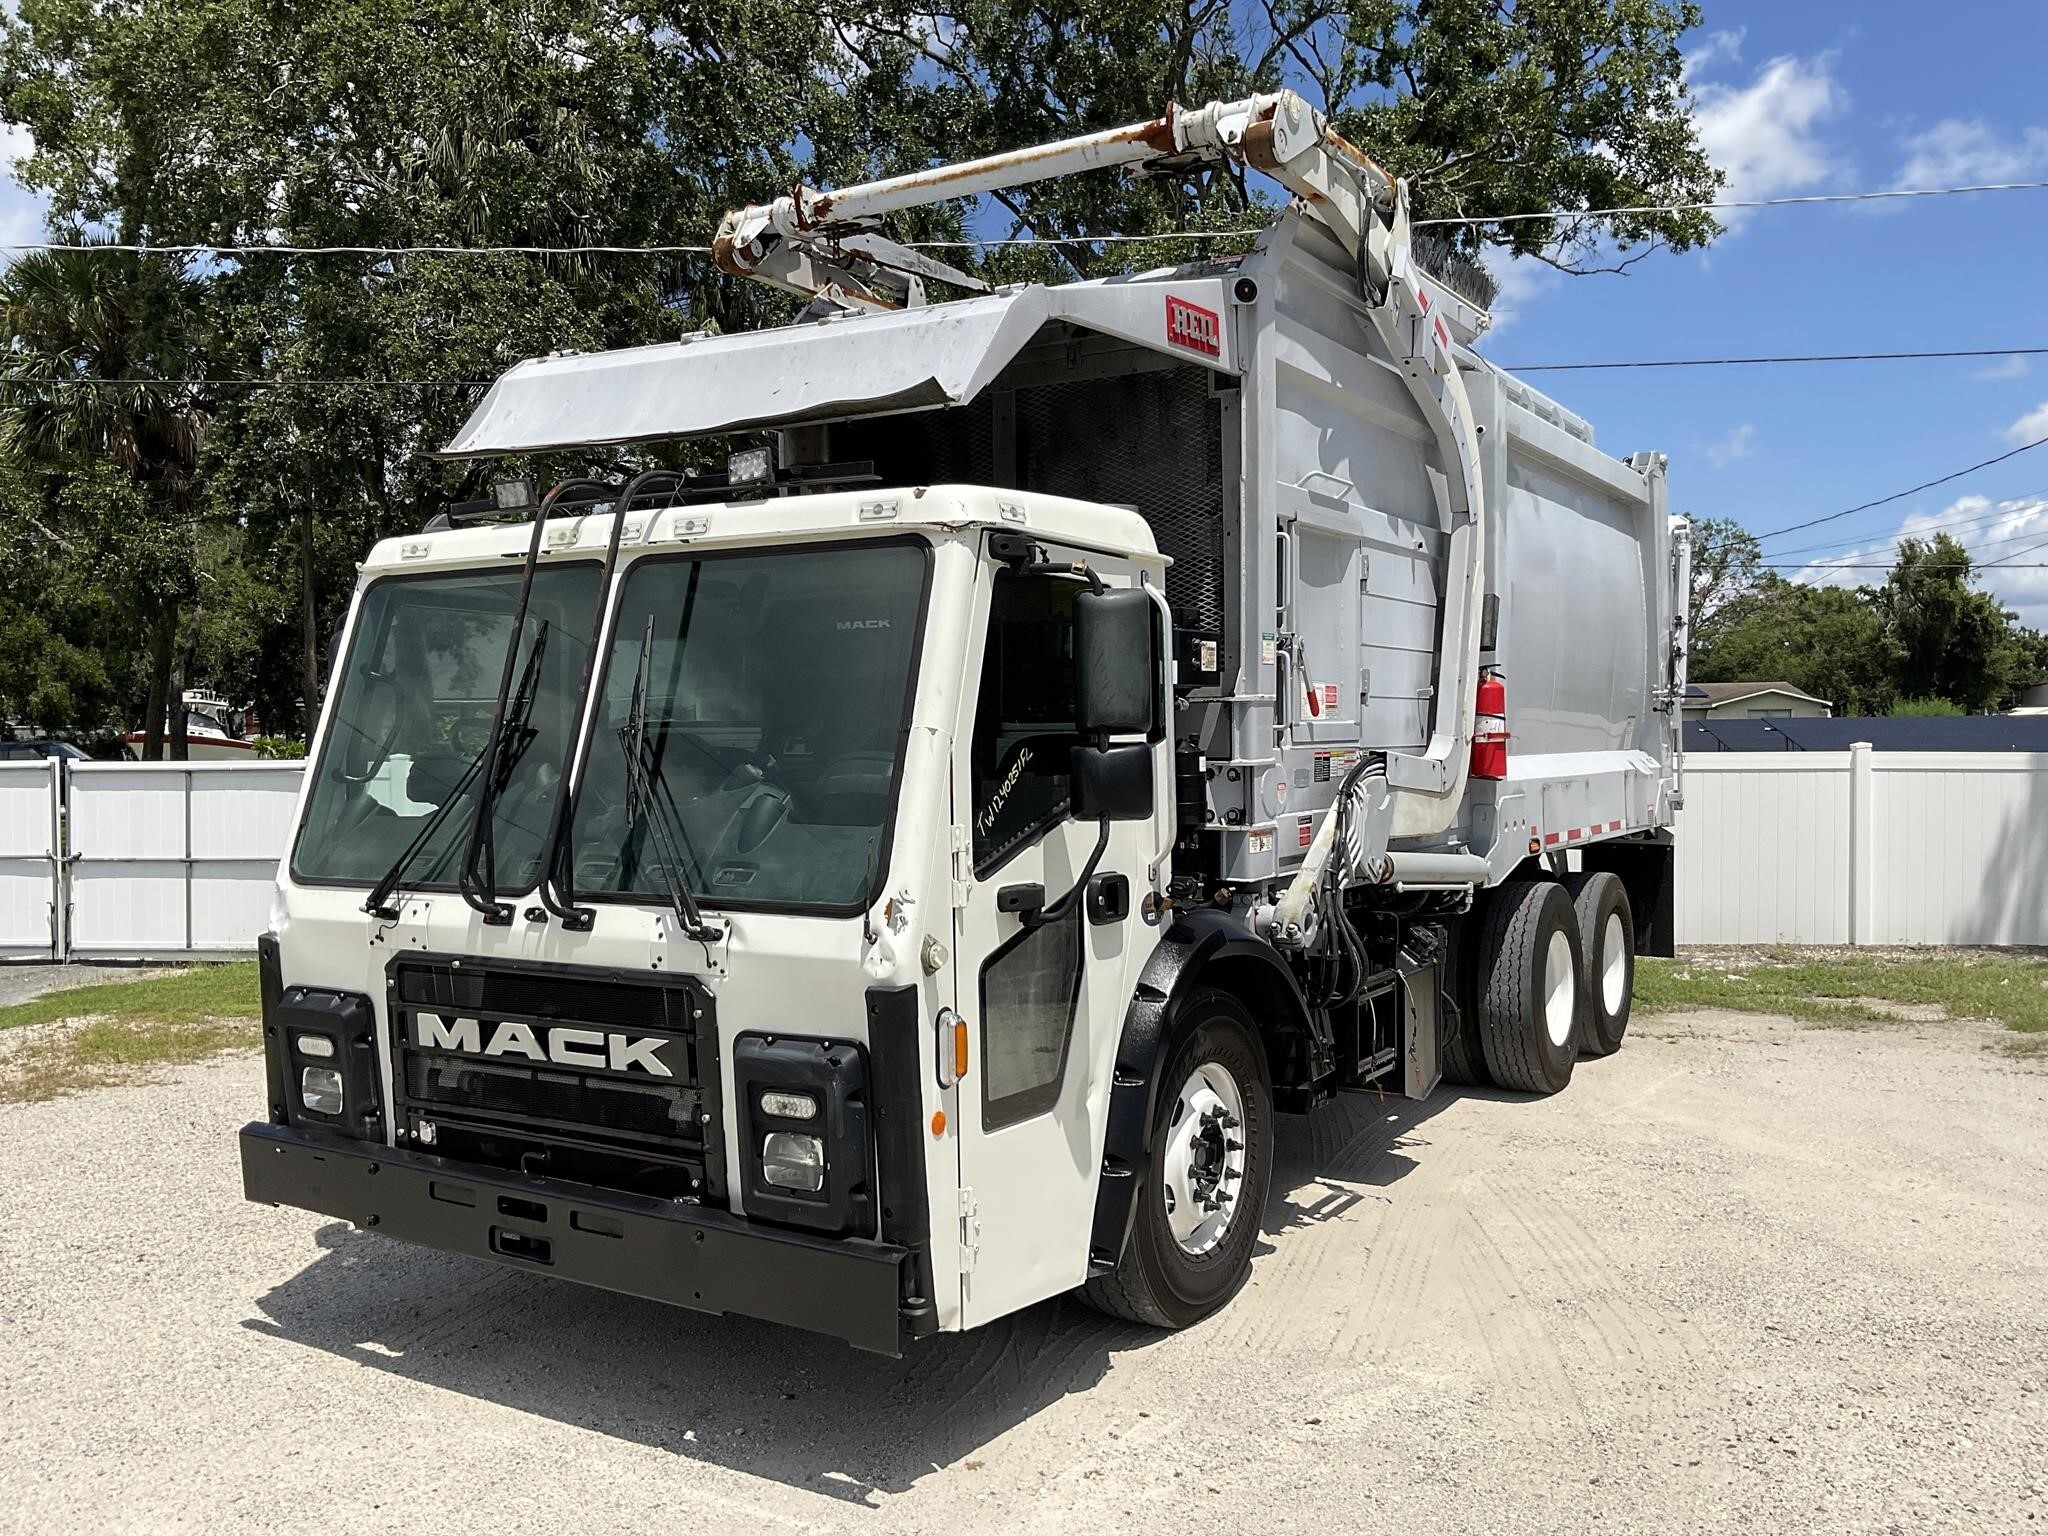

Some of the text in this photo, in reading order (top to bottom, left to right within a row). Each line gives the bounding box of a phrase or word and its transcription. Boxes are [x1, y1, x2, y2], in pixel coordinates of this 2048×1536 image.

[1172, 304, 1218, 346] HEIL
[836, 619, 891, 630] MACK
[417, 1012, 673, 1077] MACK
